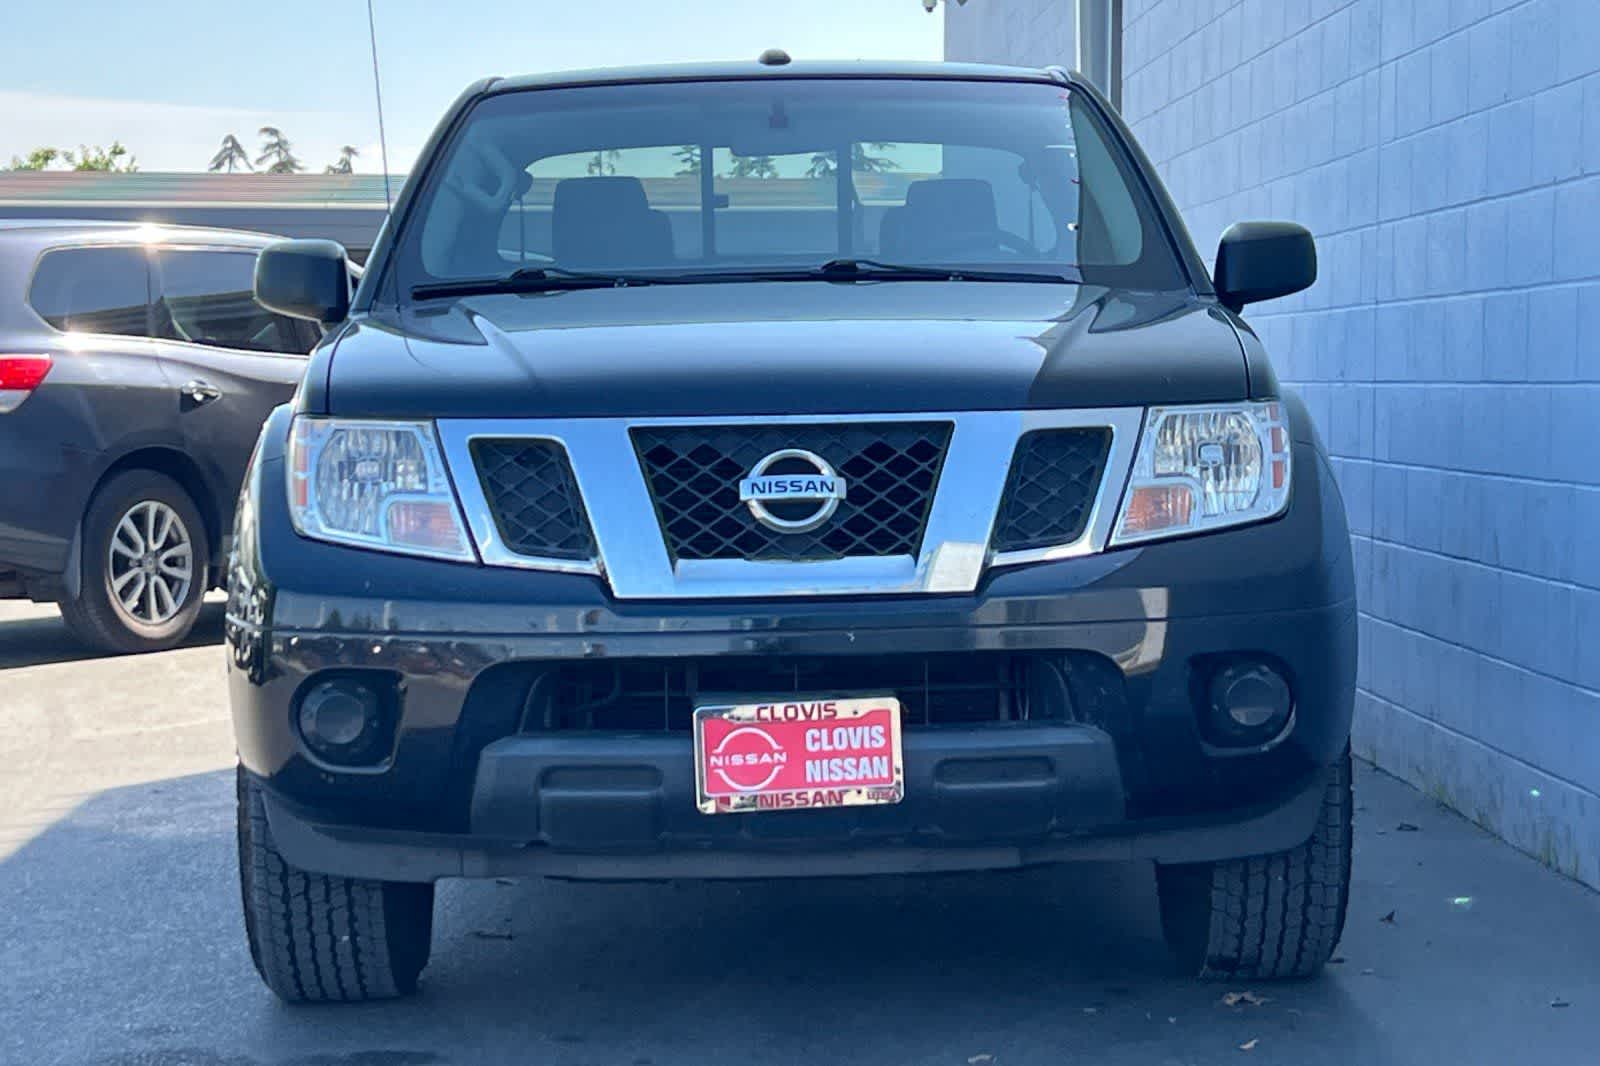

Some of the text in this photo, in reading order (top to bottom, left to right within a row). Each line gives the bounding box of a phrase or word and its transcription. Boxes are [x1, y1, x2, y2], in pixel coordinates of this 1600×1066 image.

[750, 480, 835, 494] NISSAN
[756, 702, 838, 721] CLOVIS
[805, 725, 886, 751] CLOVIS
[710, 752, 787, 766] NISSAN
[805, 756, 889, 783] NISSAN
[757, 790, 846, 809] NISSAN
